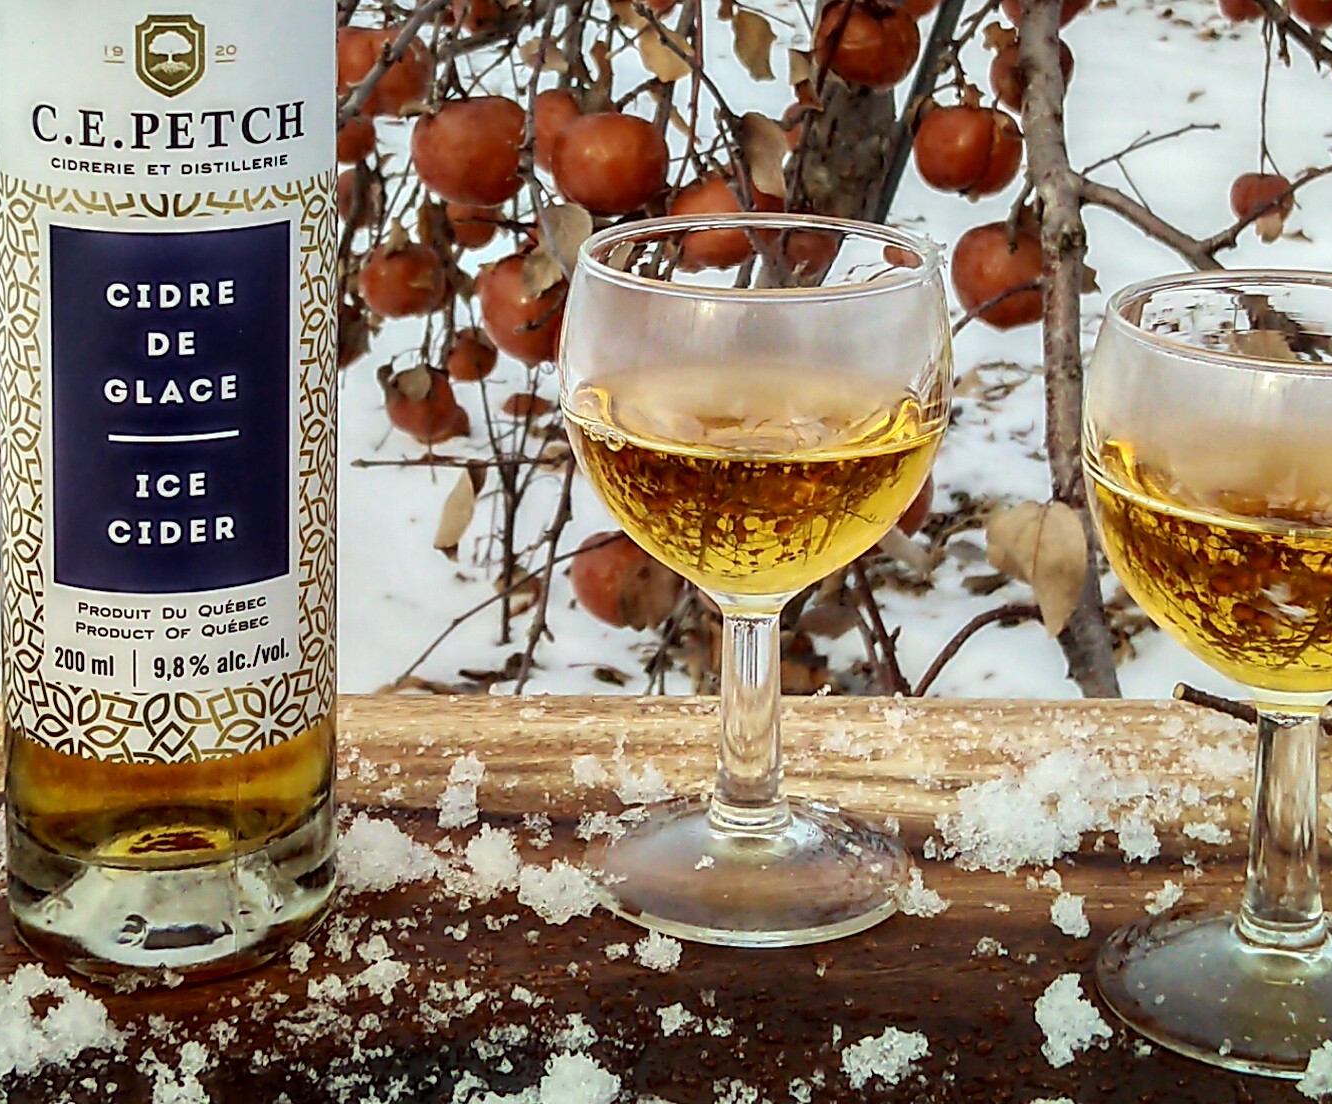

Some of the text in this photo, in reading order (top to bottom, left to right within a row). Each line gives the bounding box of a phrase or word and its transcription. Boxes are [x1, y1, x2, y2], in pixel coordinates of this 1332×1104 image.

[103, 44, 124, 57] 19
[215, 44, 237, 56] 20
[32, 100, 305, 149] C.E.PETCH
[50, 154, 289, 175] CIDRERIE ET DISTILLERIE
[106, 280, 235, 308] CIDRE
[147, 331, 195, 356] DE
[104, 375, 237, 404] GLACE
[136, 472, 206, 498] ICE
[108, 516, 235, 545] CIDER
[54, 646, 114, 676] 200 ml
[216, 637, 290, 673] alc./vol.
